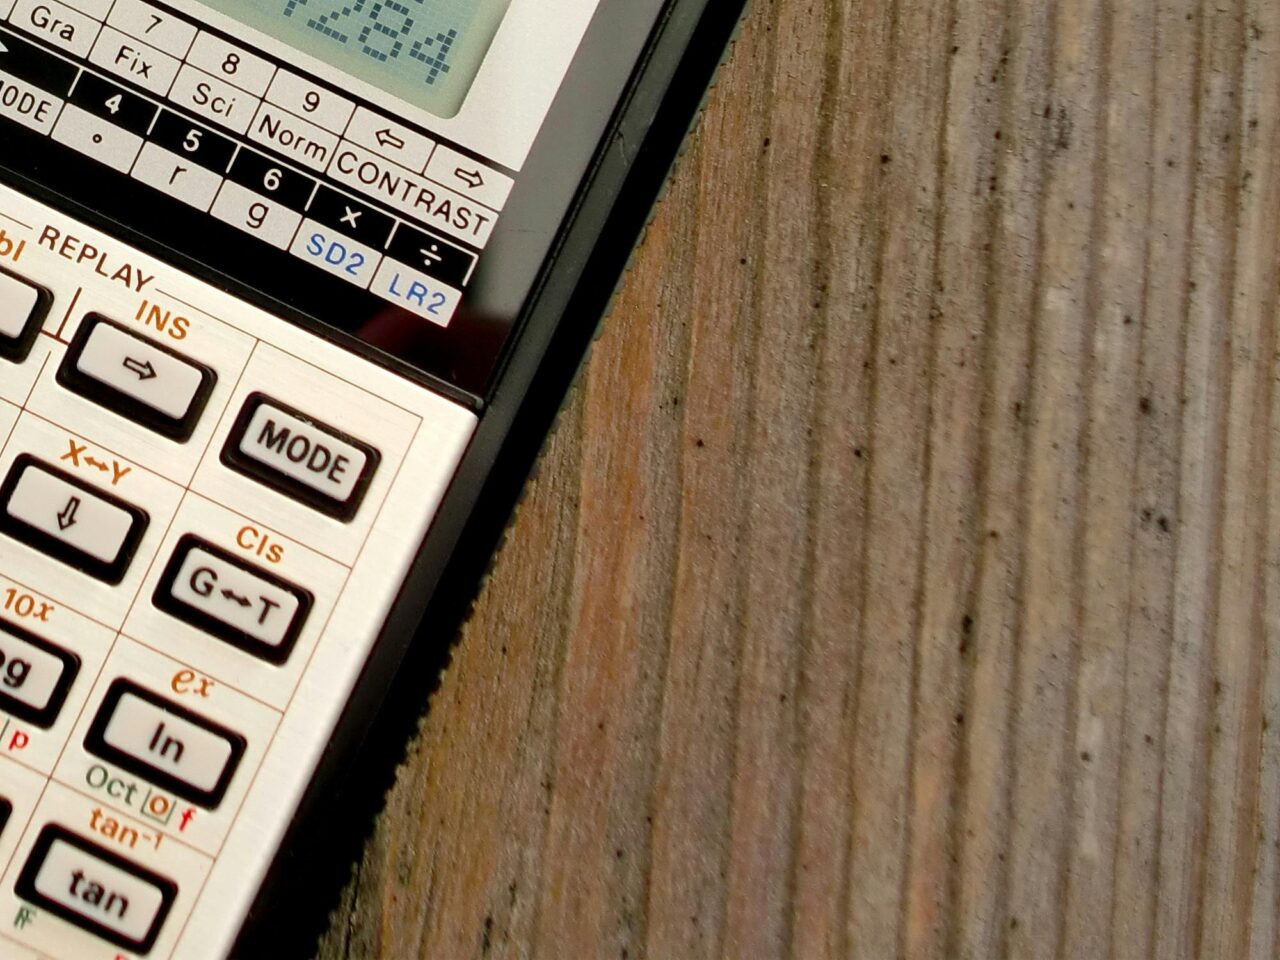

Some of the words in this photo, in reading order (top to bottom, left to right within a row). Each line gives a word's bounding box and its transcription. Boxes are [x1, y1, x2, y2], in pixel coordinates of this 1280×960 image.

[30, 5, 75, 42] Gra
[144, 14, 163, 34] 7
[114, 45, 152, 78] Fix
[221, 52, 240, 75] 8
[104, 93, 122, 114] 4
[192, 82, 235, 117] Sci
[302, 90, 320, 113] 9
[182, 128, 203, 152] 5
[258, 114, 327, 161] Norm
[168, 165, 187, 185] r
[263, 168, 283, 191] 6
[337, 151, 488, 234] CONTRAST
[246, 202, 269, 229] g
[38, 225, 153, 292] REPLAY
[306, 233, 364, 275] SD2
[388, 273, 446, 314] LR2
[135, 299, 190, 340] INS
[257, 419, 348, 483] MODE
[8, 730, 29, 750] p
[85, 764, 137, 805] Oct
[179, 808, 194, 831] f
[69, 871, 129, 918] tan
